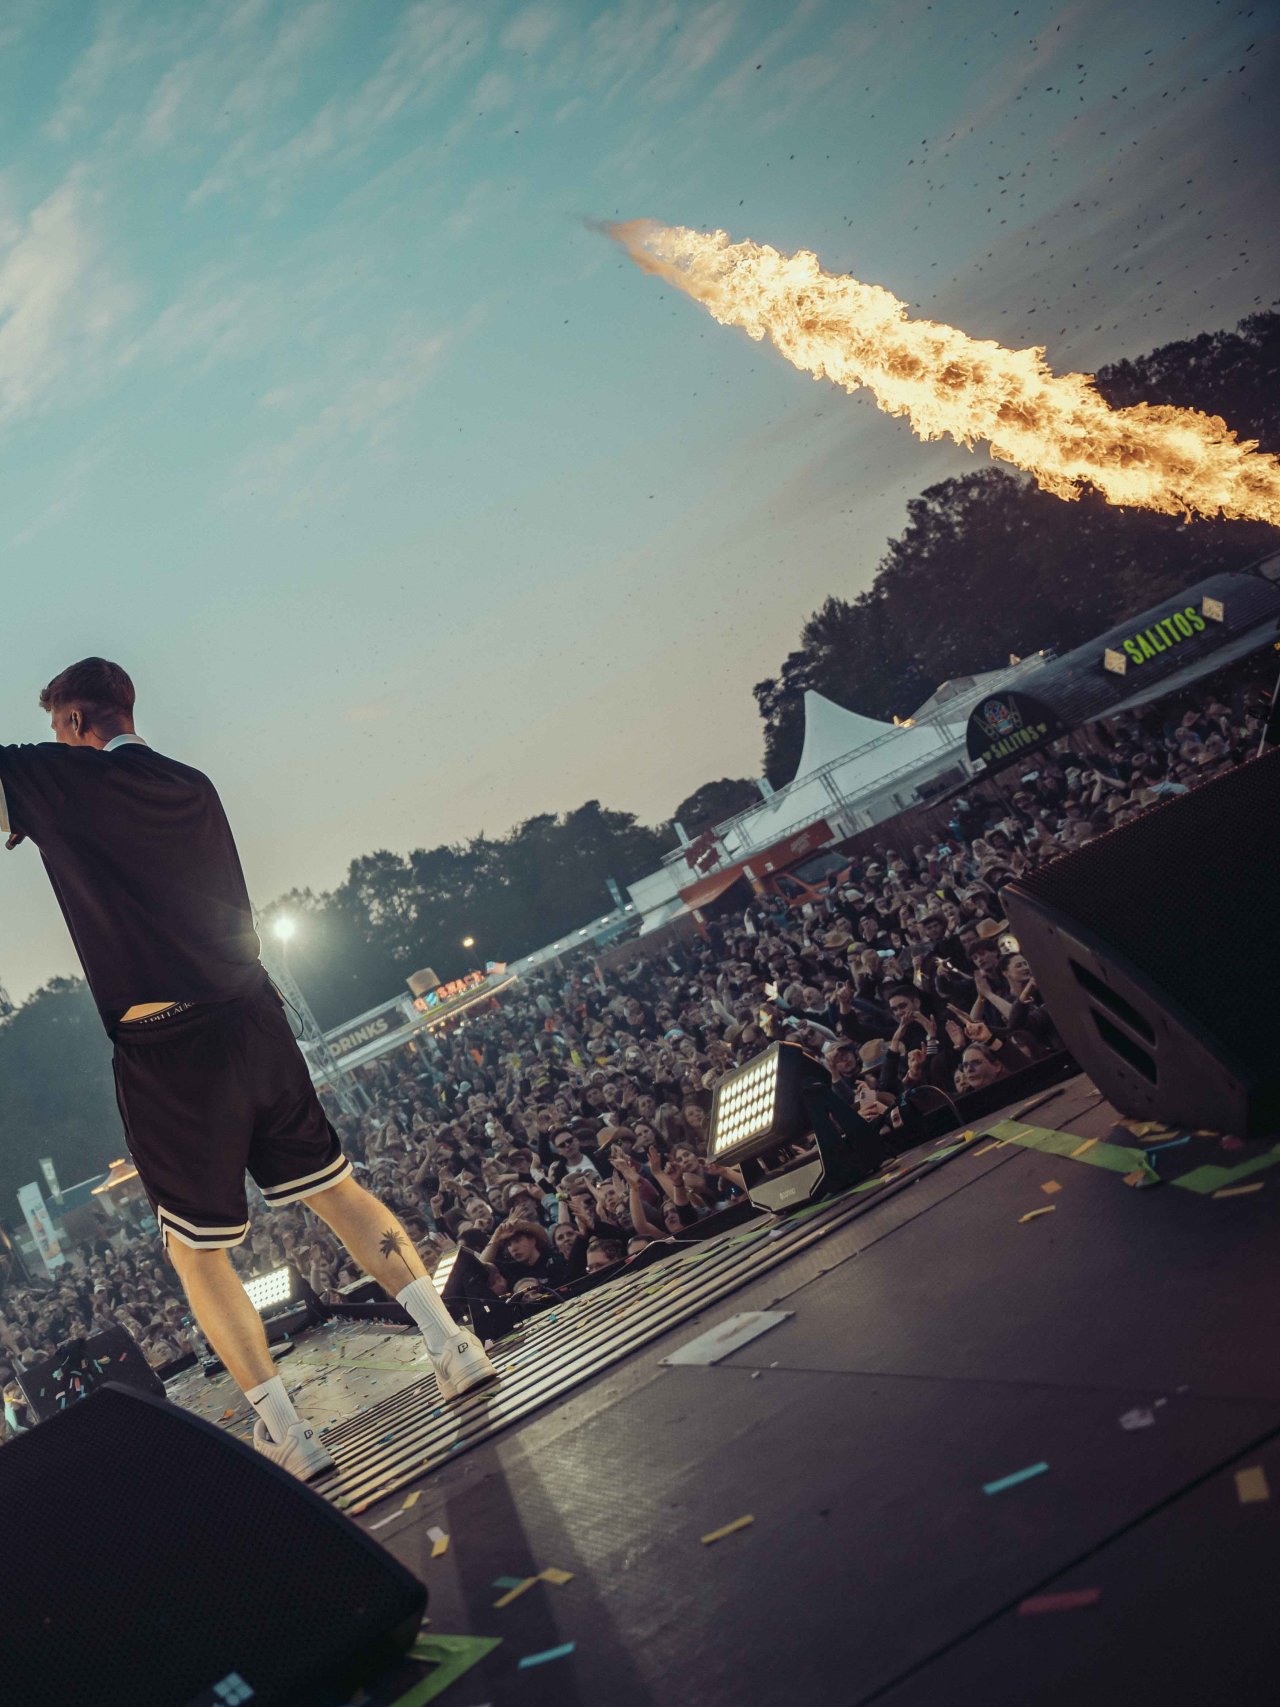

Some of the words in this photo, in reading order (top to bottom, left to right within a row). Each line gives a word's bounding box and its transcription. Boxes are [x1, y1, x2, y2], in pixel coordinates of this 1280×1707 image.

[1123, 606, 1205, 664] SALITOS
[991, 727, 1039, 759] SALITOS
[328, 1018, 388, 1056] DRINKS
